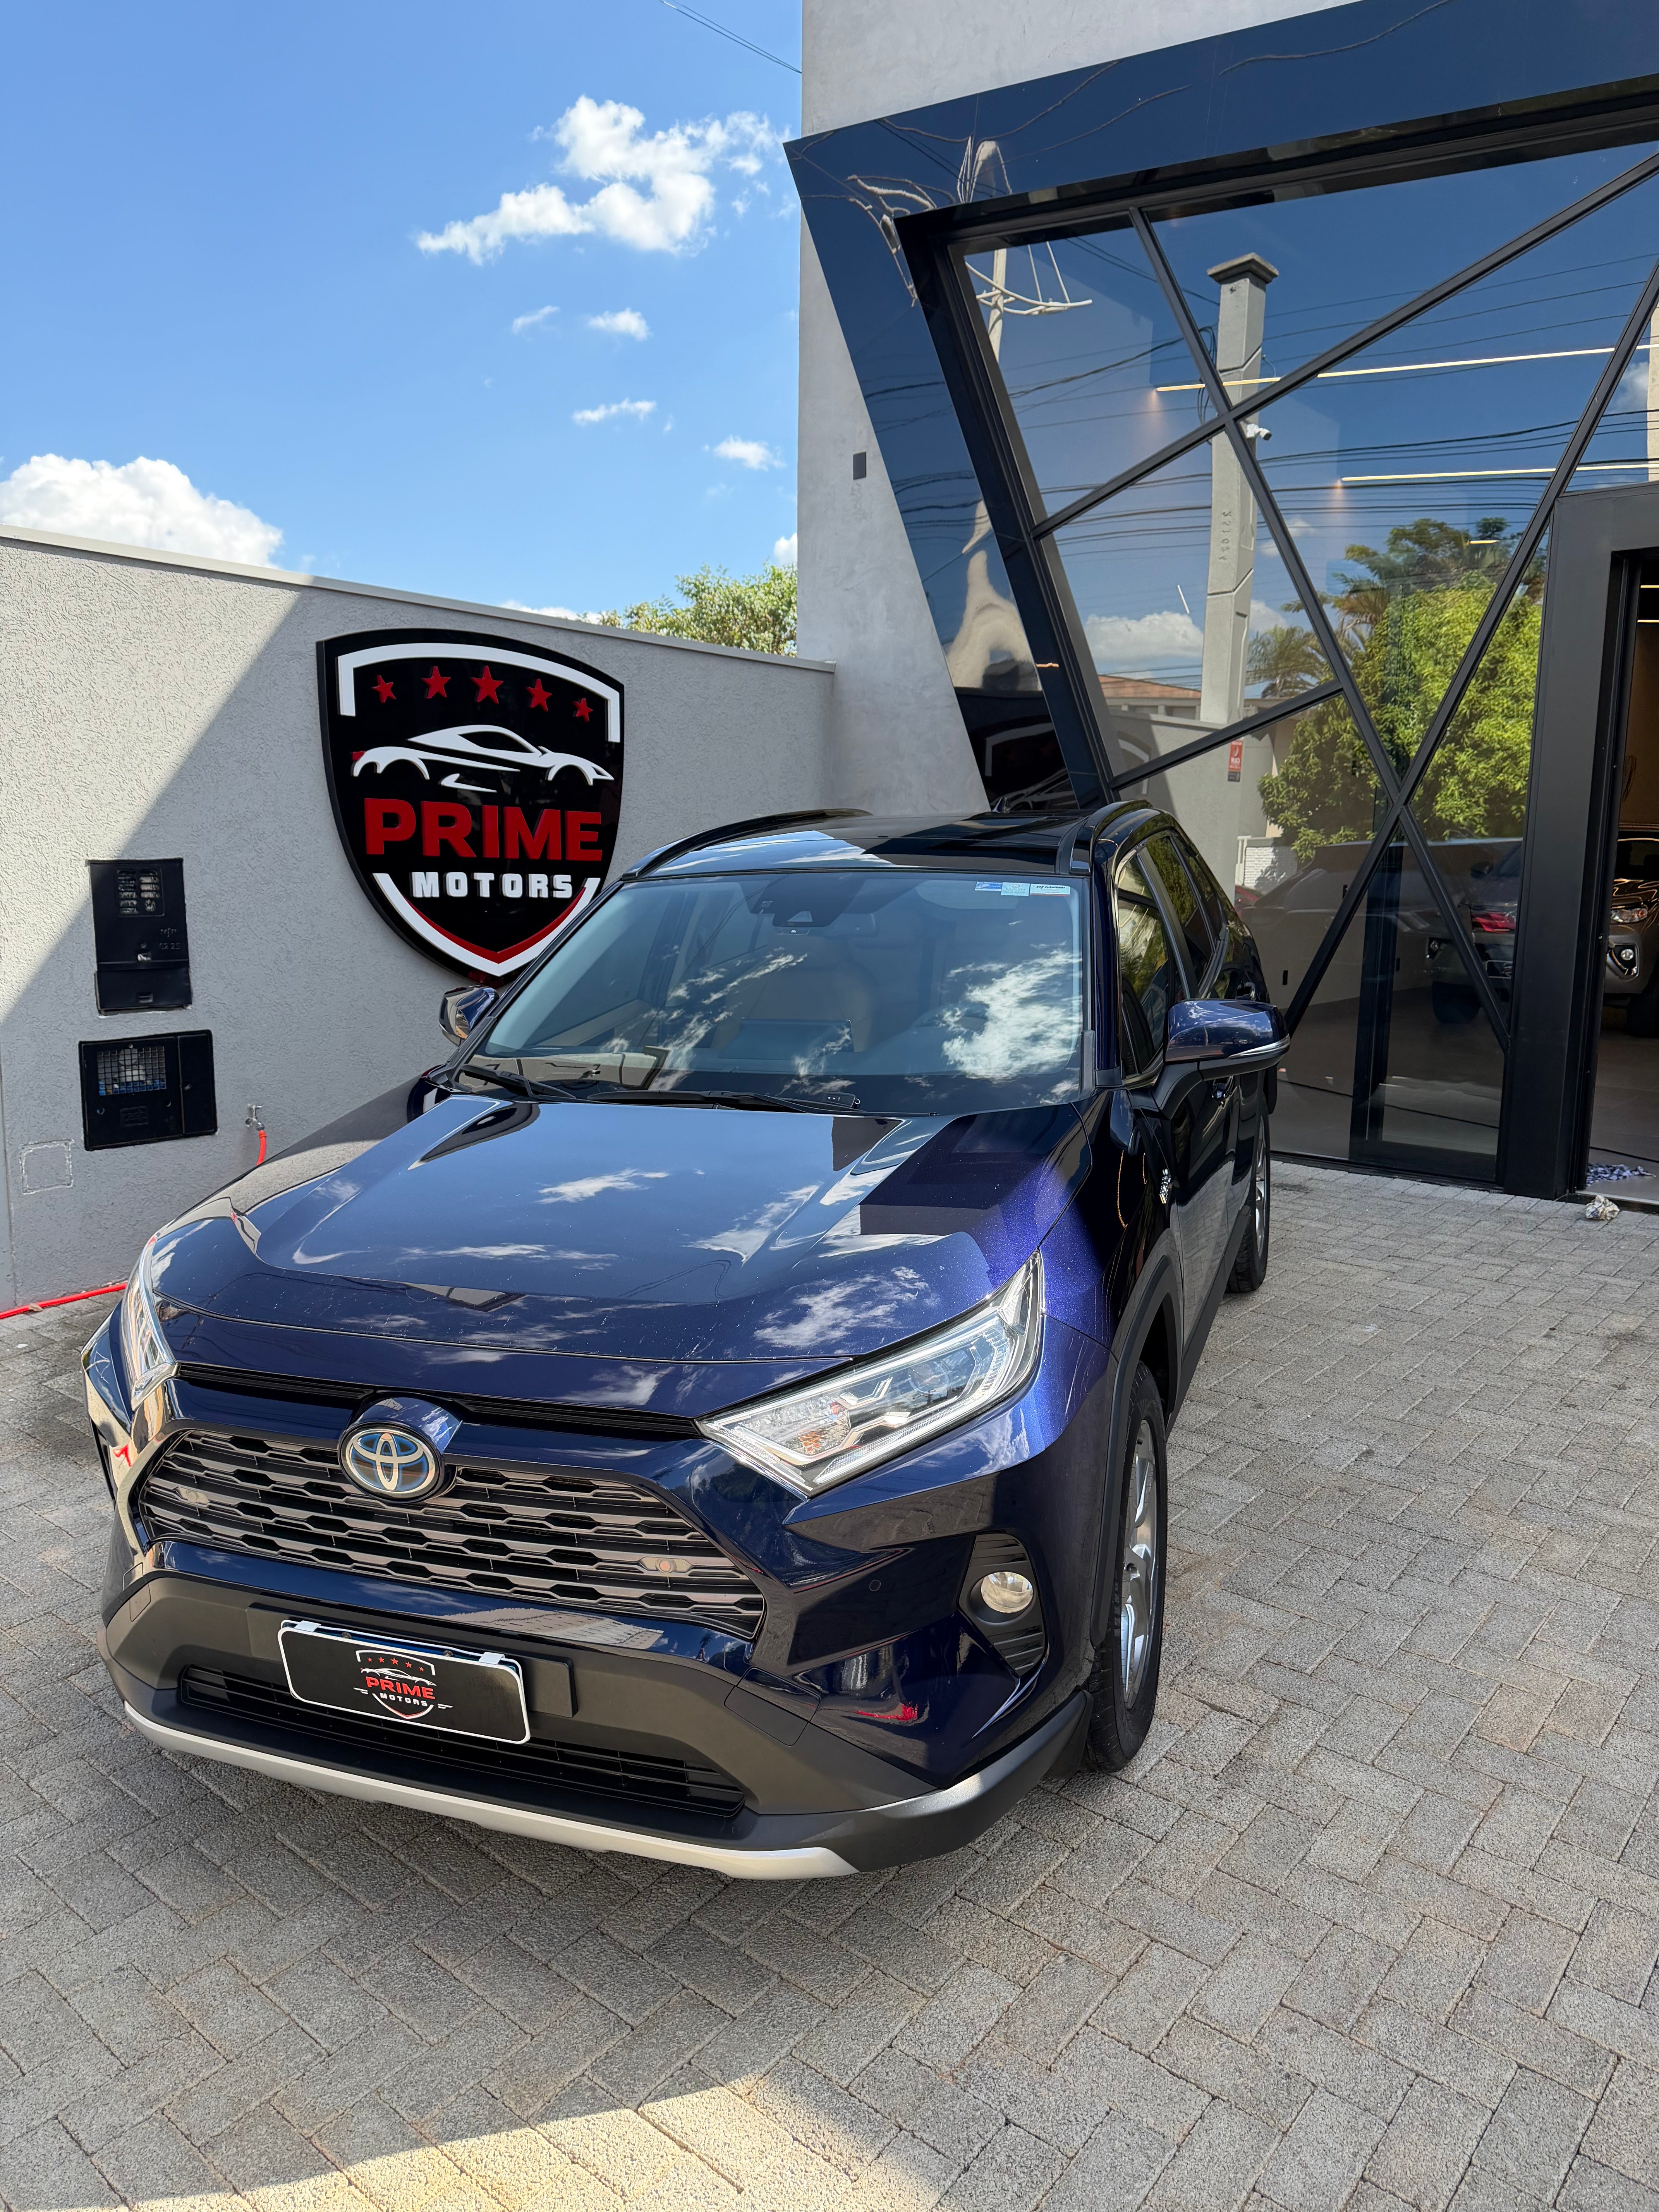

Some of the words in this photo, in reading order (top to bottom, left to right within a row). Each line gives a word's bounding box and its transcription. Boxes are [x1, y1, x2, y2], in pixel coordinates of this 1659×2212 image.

[364, 798, 603, 861] PRIME
[411, 872, 572, 898] MOTORS
[366, 1676, 435, 1699] PRIME
[380, 1693, 428, 1706] MOTORS
